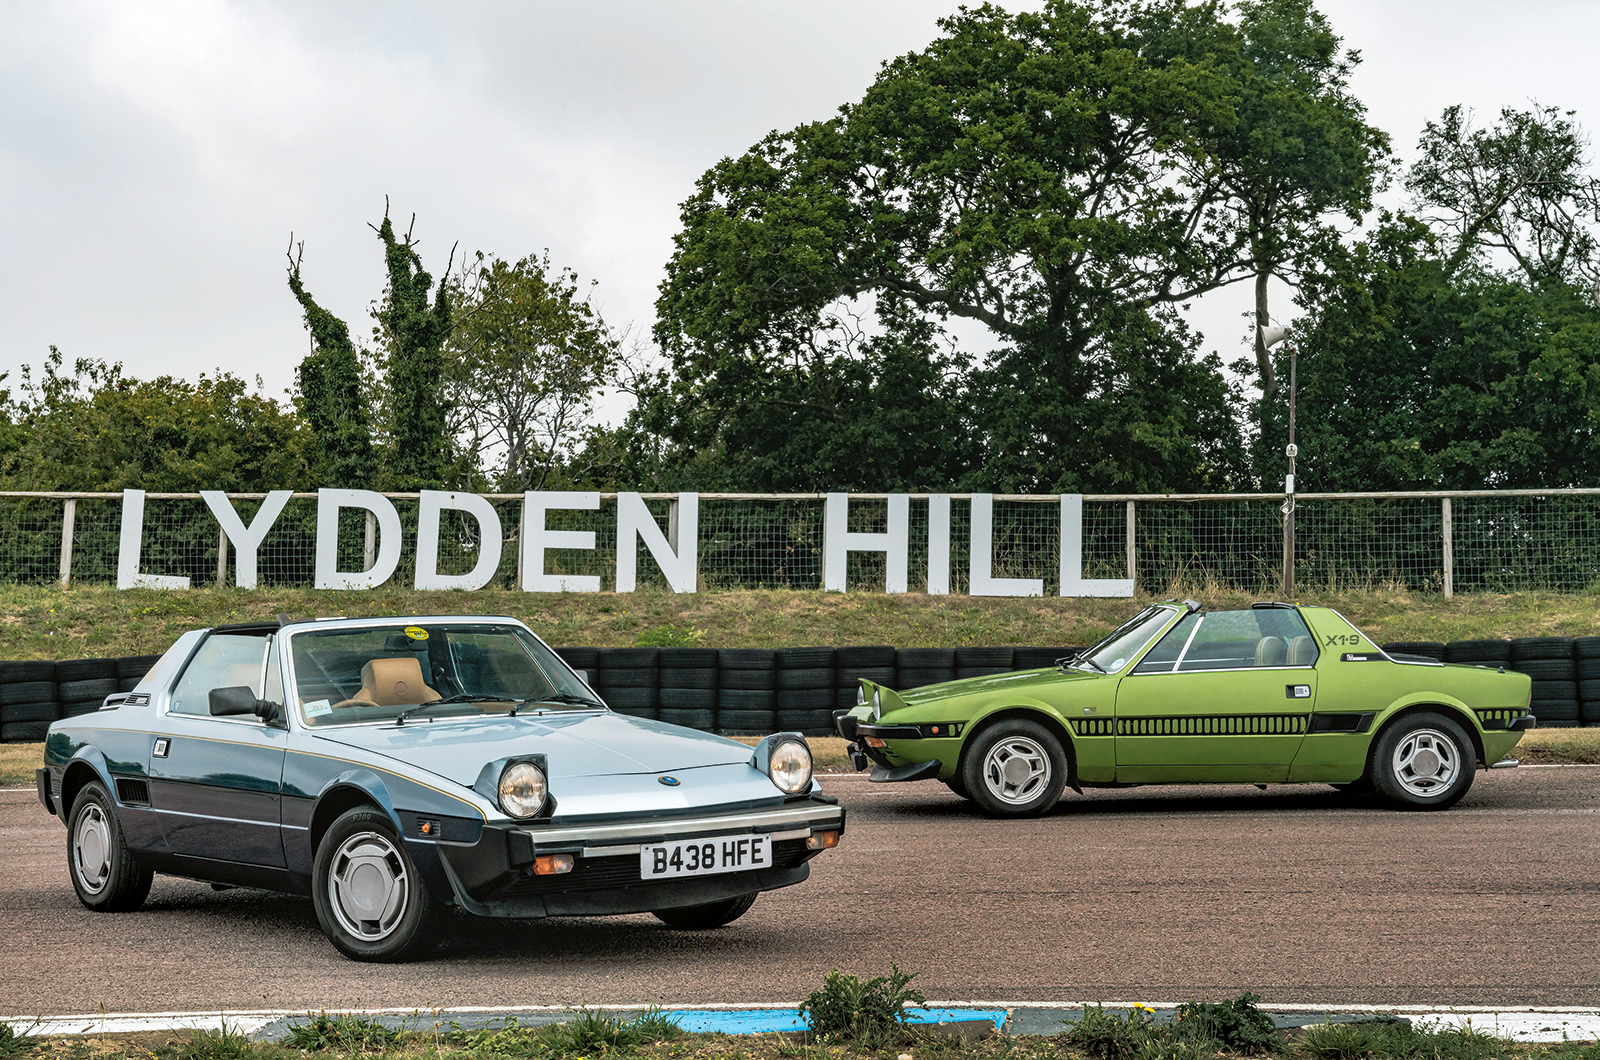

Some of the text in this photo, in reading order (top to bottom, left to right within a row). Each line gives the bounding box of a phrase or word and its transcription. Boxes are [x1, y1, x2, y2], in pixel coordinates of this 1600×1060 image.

[117, 488, 1134, 597] LYDDEN HILL
[352, 813, 372, 822] P309
[652, 838, 764, 874] B438 HFE
